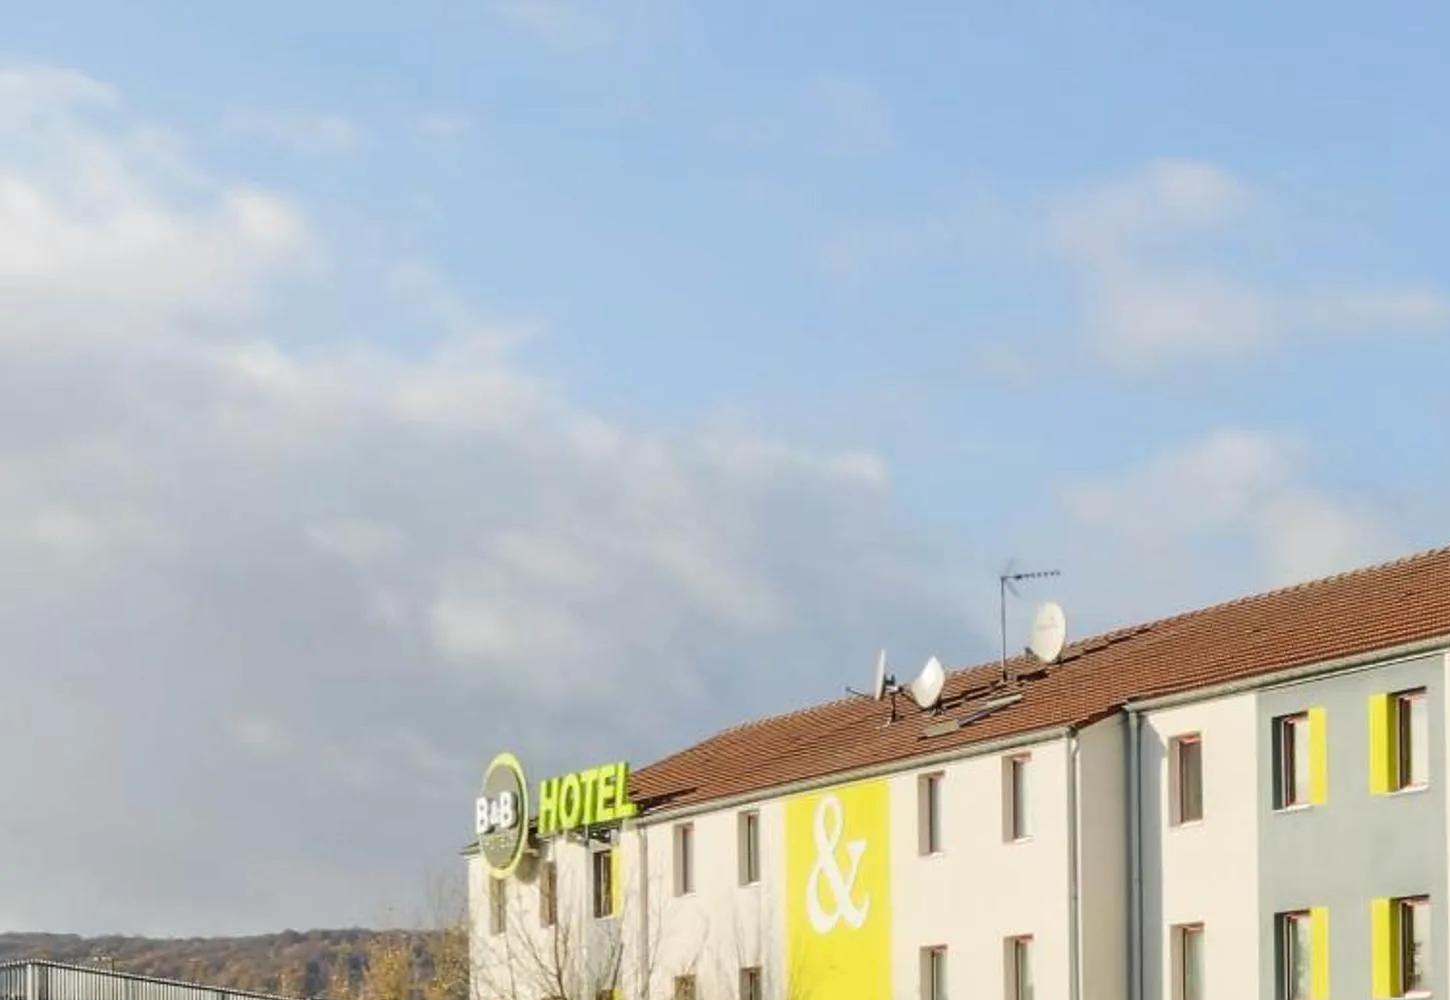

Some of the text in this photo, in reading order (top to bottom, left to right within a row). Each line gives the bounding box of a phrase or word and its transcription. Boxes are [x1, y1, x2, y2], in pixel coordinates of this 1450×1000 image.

[476, 791, 513, 834] B&B
[539, 761, 637, 835] HOTEL
[806, 795, 870, 934] &
